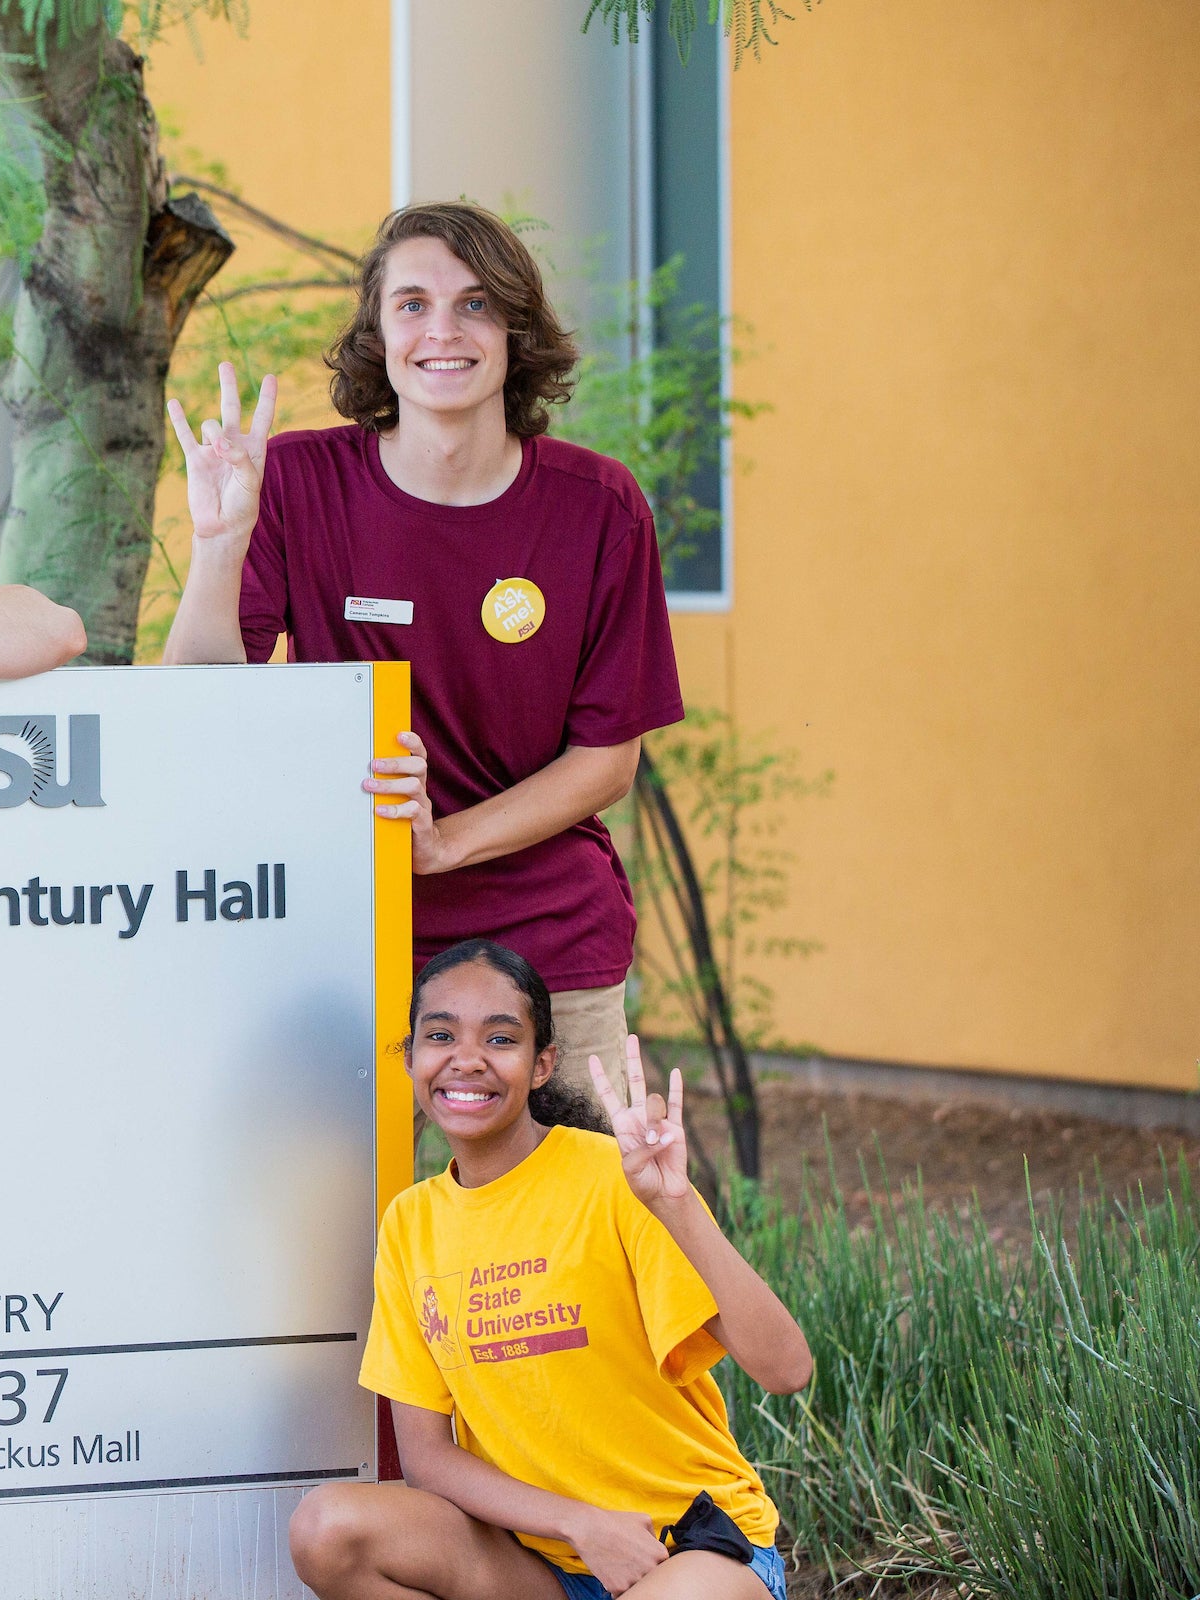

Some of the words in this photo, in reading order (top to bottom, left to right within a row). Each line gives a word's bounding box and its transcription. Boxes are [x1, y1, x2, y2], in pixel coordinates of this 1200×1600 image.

[493, 588, 528, 619] Ask
[502, 599, 535, 632] me!
[517, 620, 536, 638] ASU
[176, 863, 286, 922] Hall
[469, 1257, 547, 1288] Arizona
[468, 1286, 521, 1313] State
[466, 1302, 581, 1338] University
[474, 1348, 498, 1361] Est.
[501, 1342, 530, 1358] 1885
[73, 1430, 140, 1465] Mall
